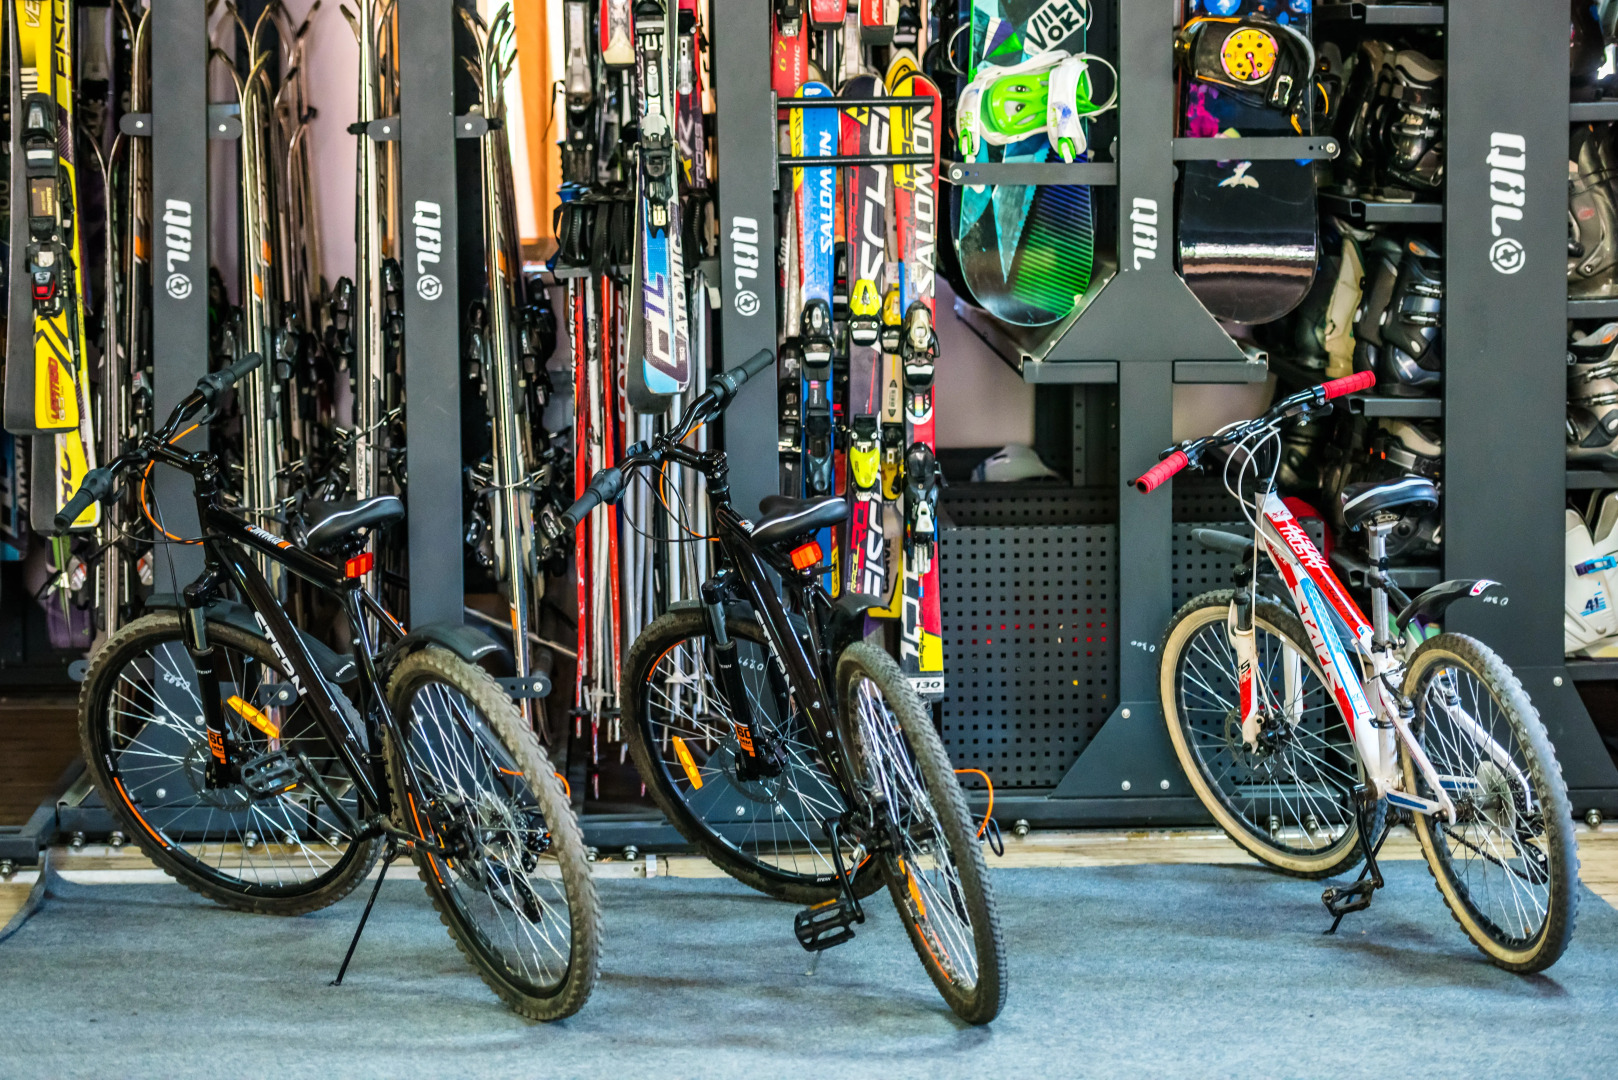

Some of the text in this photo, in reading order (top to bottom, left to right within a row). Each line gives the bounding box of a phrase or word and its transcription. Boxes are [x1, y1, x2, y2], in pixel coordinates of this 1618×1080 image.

[819, 129, 833, 256] SALOMN
[912, 106, 936, 297] SALOMON
[669, 228, 690, 341] ATOMIC
[1279, 525, 1318, 570] TROSTY
[850, 552, 860, 593] RACE
[1585, 597, 1600, 611] 41
[254, 611, 307, 697] STERN
[915, 681, 941, 689] 130
[209, 733, 225, 745] 60
[737, 728, 751, 737] 60
